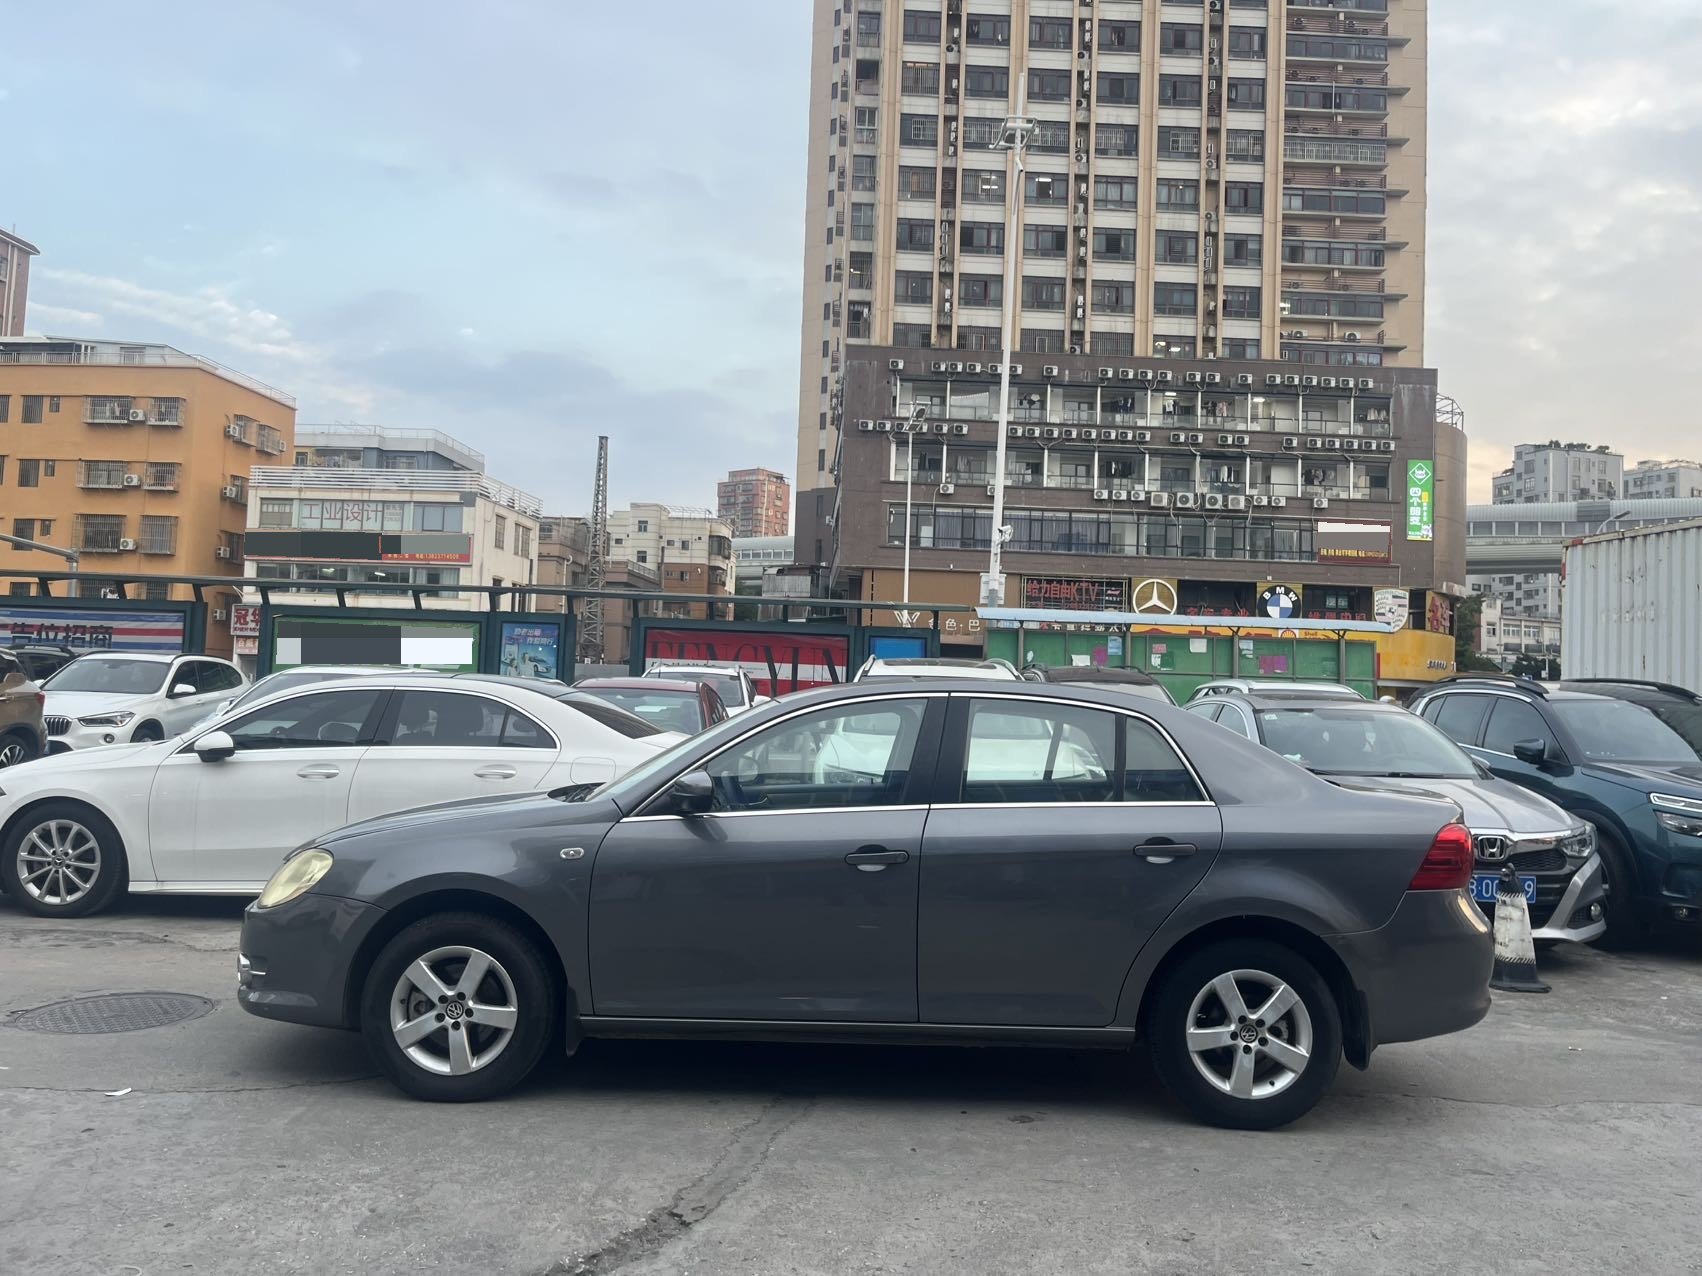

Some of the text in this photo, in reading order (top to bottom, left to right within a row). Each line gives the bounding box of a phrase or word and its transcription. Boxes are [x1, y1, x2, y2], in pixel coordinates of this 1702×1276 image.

[301, 503, 382, 523] 工业设计
[1262, 585, 1298, 601] BMW
